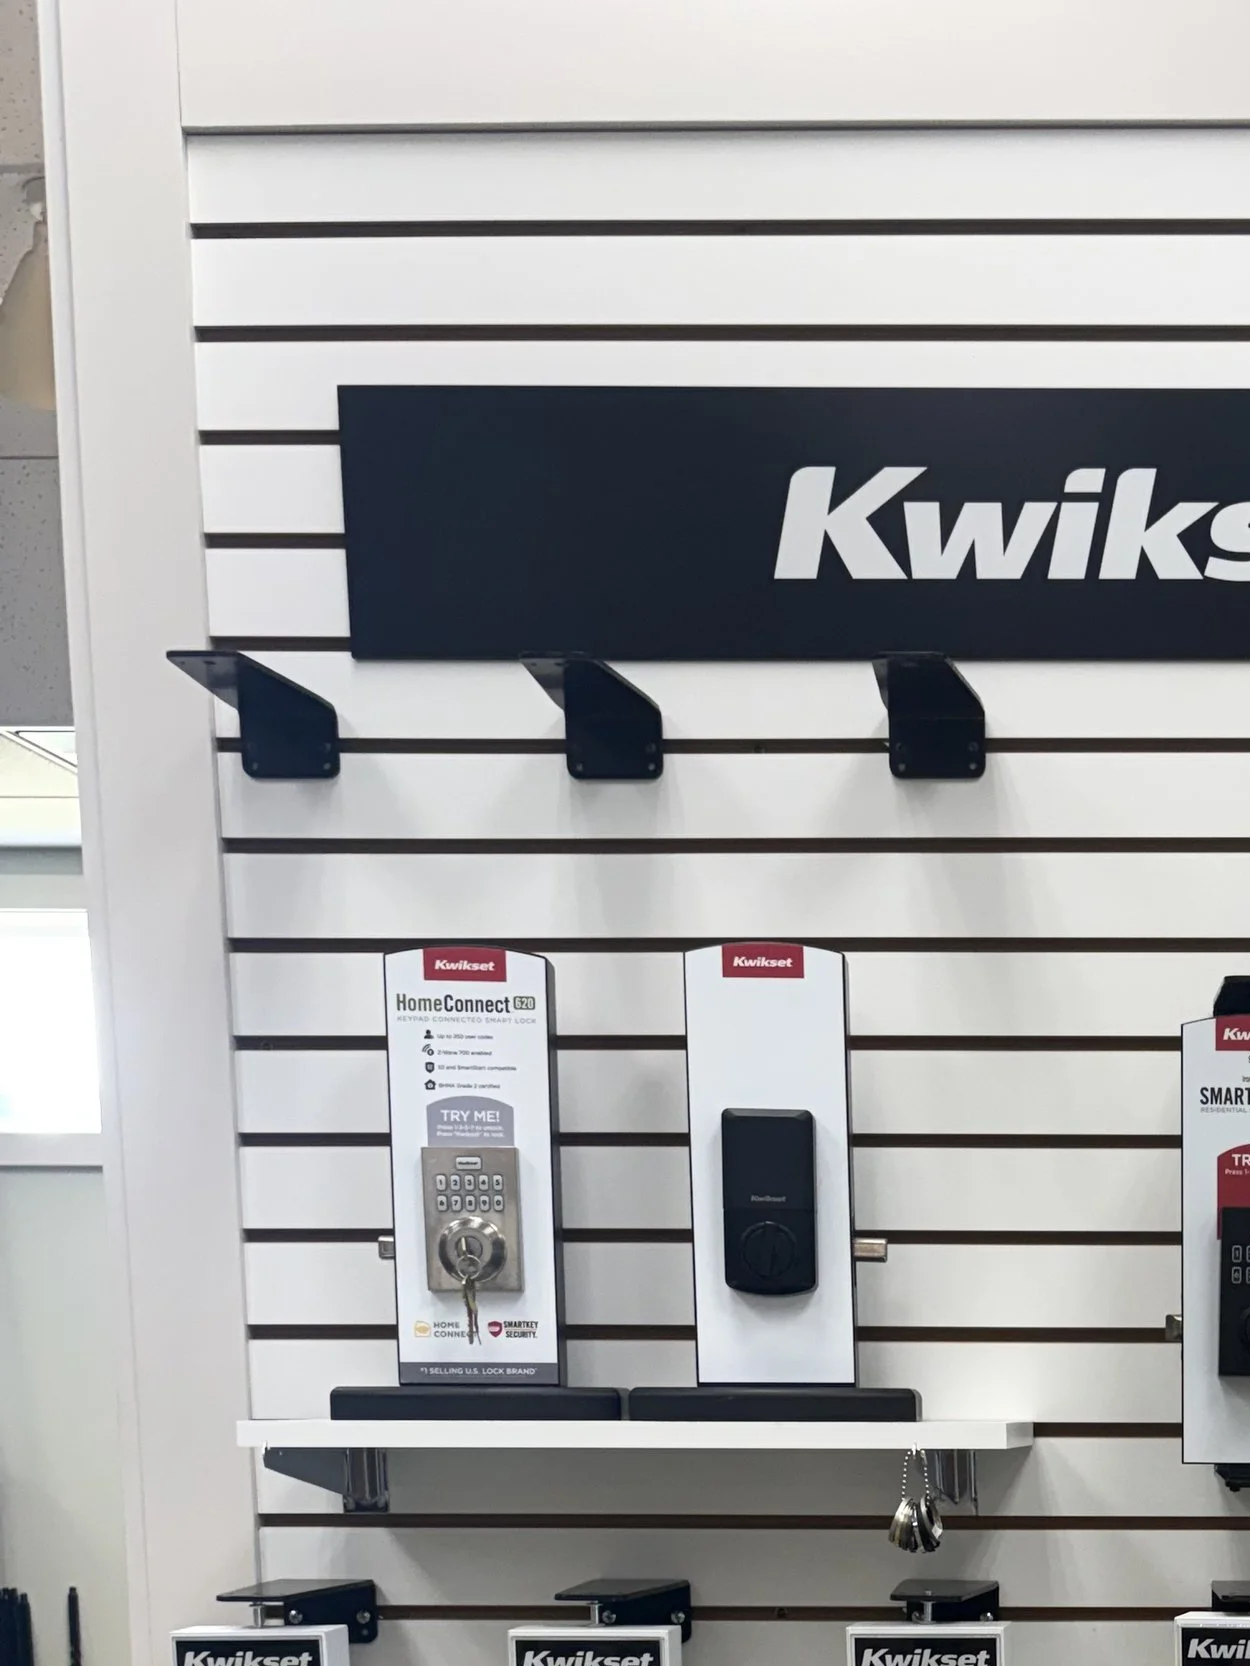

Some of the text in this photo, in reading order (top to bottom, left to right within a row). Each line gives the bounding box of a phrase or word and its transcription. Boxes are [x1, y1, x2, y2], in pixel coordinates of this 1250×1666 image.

[434, 959, 495, 971] Kwikset
[732, 956, 793, 968] Kwikset
[396, 993, 534, 1013] HomeConnect 620
[440, 1110, 500, 1122] TRY ME!
[503, 1321, 538, 1329] SMARTKEY
